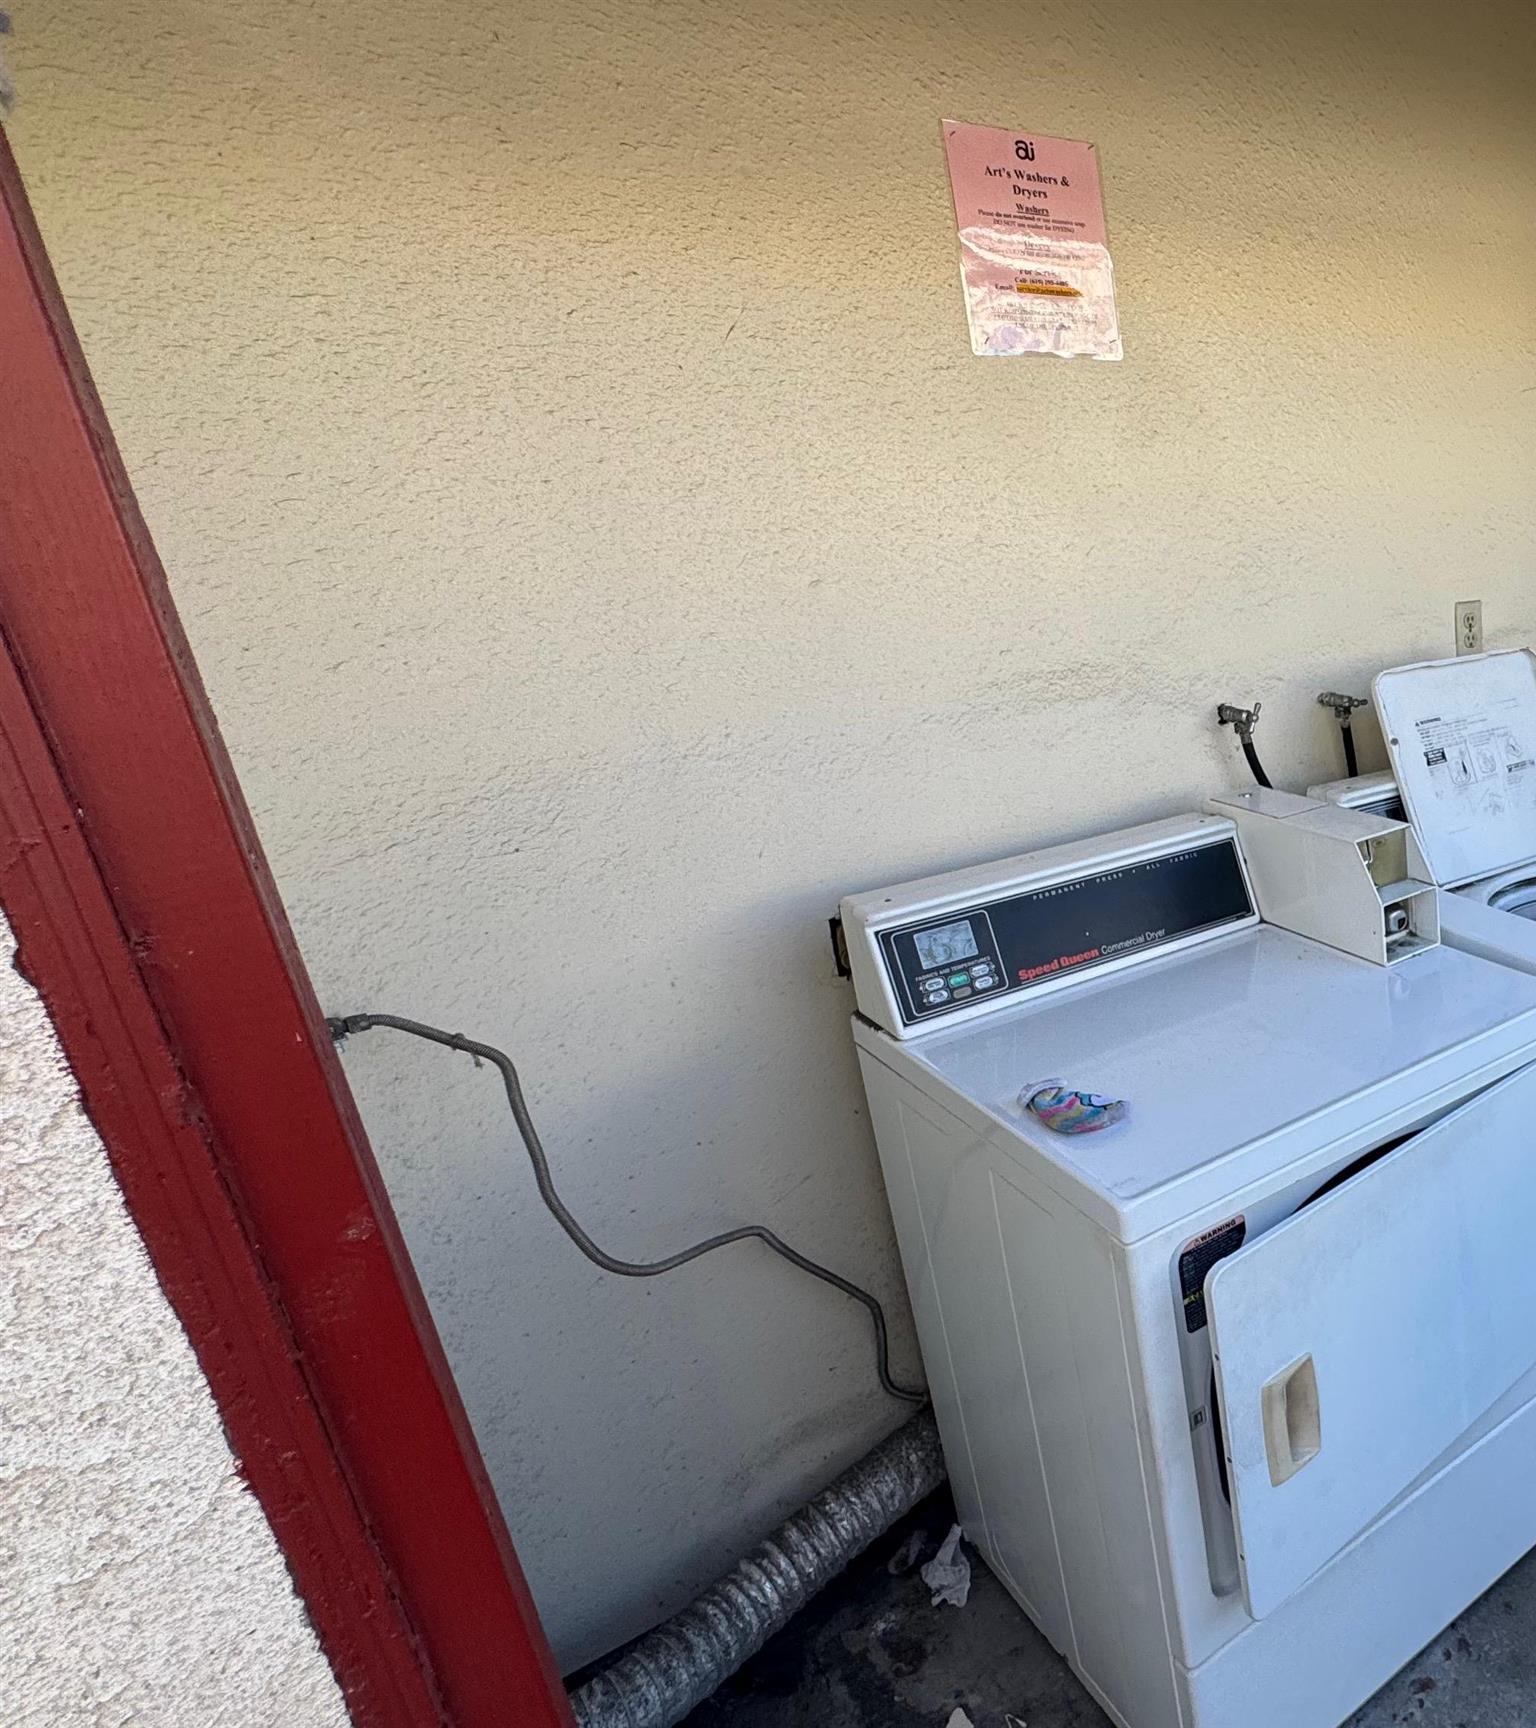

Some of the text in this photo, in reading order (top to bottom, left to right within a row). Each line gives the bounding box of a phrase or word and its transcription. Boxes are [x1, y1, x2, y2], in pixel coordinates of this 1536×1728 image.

[984, 165, 1070, 187] Art's Washers &
[1012, 184, 1048, 200] Dryers
[1015, 203, 1049, 215] Washers
[1032, 882, 1086, 901] PERMANENT
[1096, 872, 1124, 884] PRESS
[1017, 928, 1166, 981] Speed Queen Commercial Dryer
[1200, 1218, 1237, 1242] WARNING
